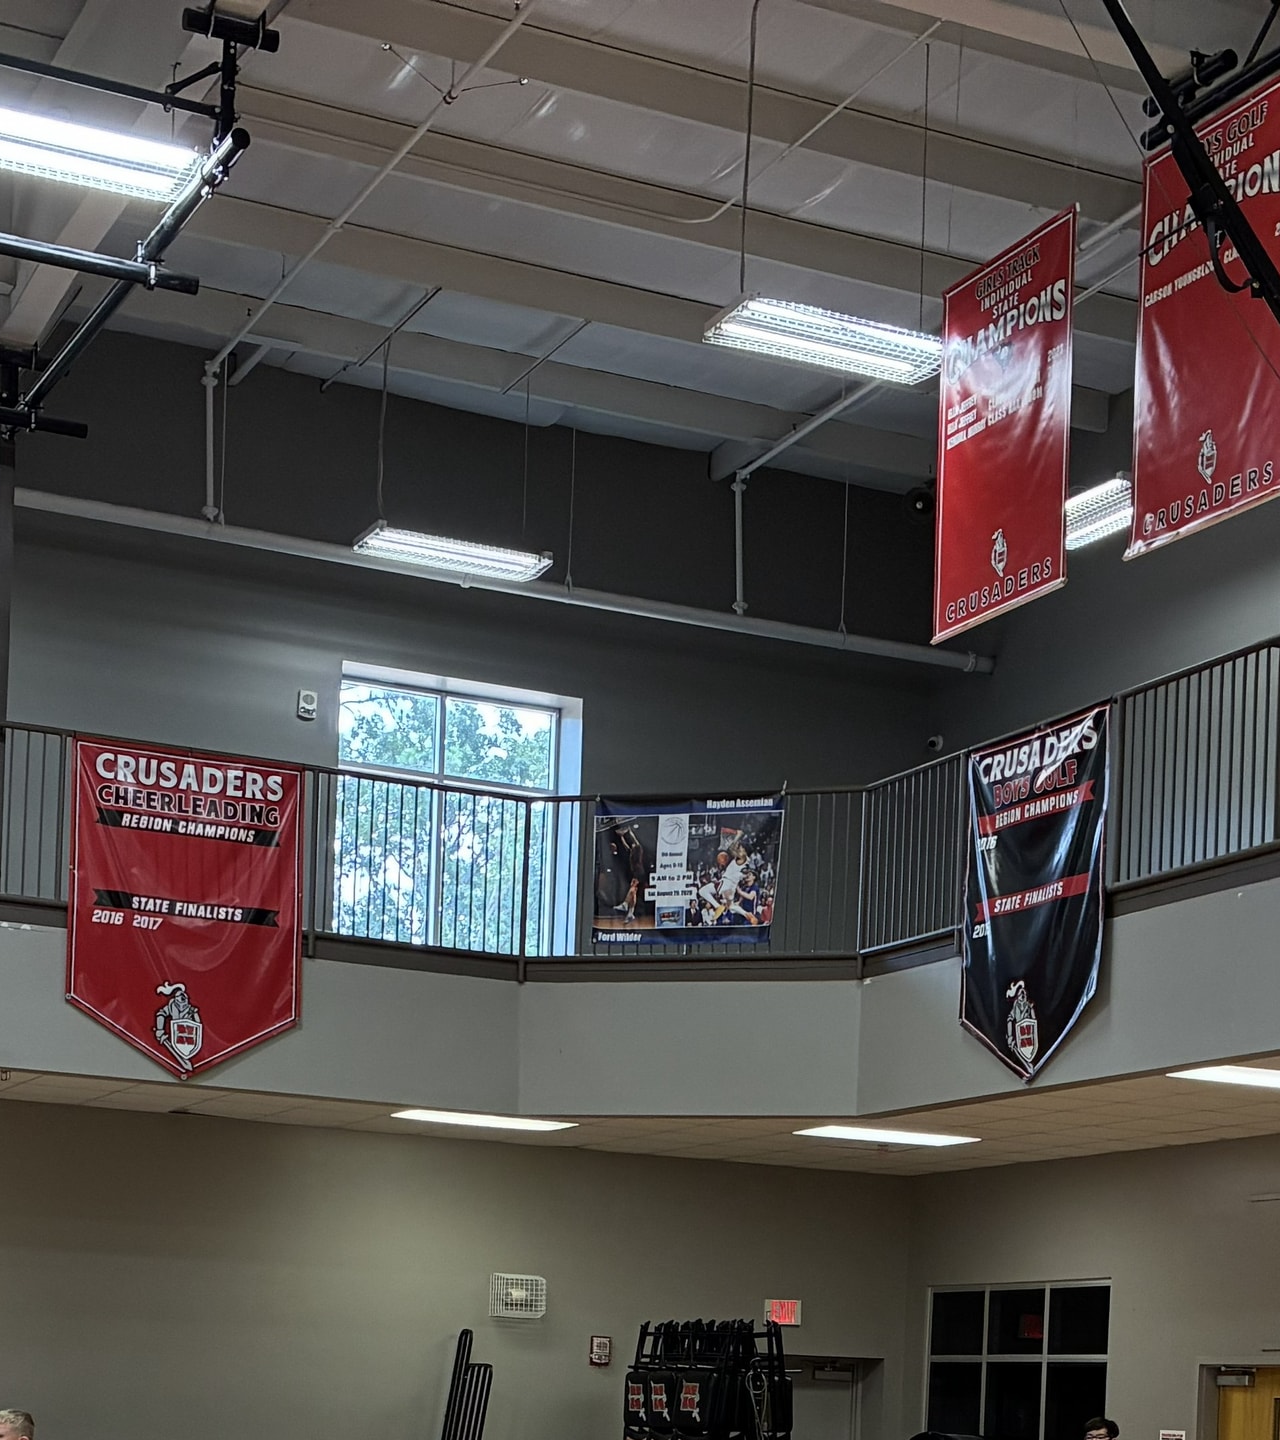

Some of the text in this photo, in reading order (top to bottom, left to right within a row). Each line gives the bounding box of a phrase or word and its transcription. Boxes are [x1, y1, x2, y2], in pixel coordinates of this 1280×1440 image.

[1226, 100, 1268, 143] GOLF
[976, 243, 1040, 300] GIRLS TRACK
[980, 269, 1032, 312] INDIVIDUAL
[992, 292, 1019, 319] STATE
[949, 279, 1066, 385] CHAMPIONS
[1143, 461, 1273, 535] CRUSADERS
[946, 557, 1052, 623] CRUSADERS
[979, 722, 1098, 785] CRUSADERS
[96, 752, 283, 802] CRUSADERS
[993, 774, 1031, 809] BOYS
[96, 783, 280, 828] CHEERLEADING
[995, 790, 1079, 828] REGION CHAMPIONS
[121, 814, 256, 844] REGION CHAMPIONS
[132, 896, 243, 922] STATE FINALISTS
[994, 882, 1063, 913] STATE FINALISTS
[92, 909, 163, 931] 2016 2017
